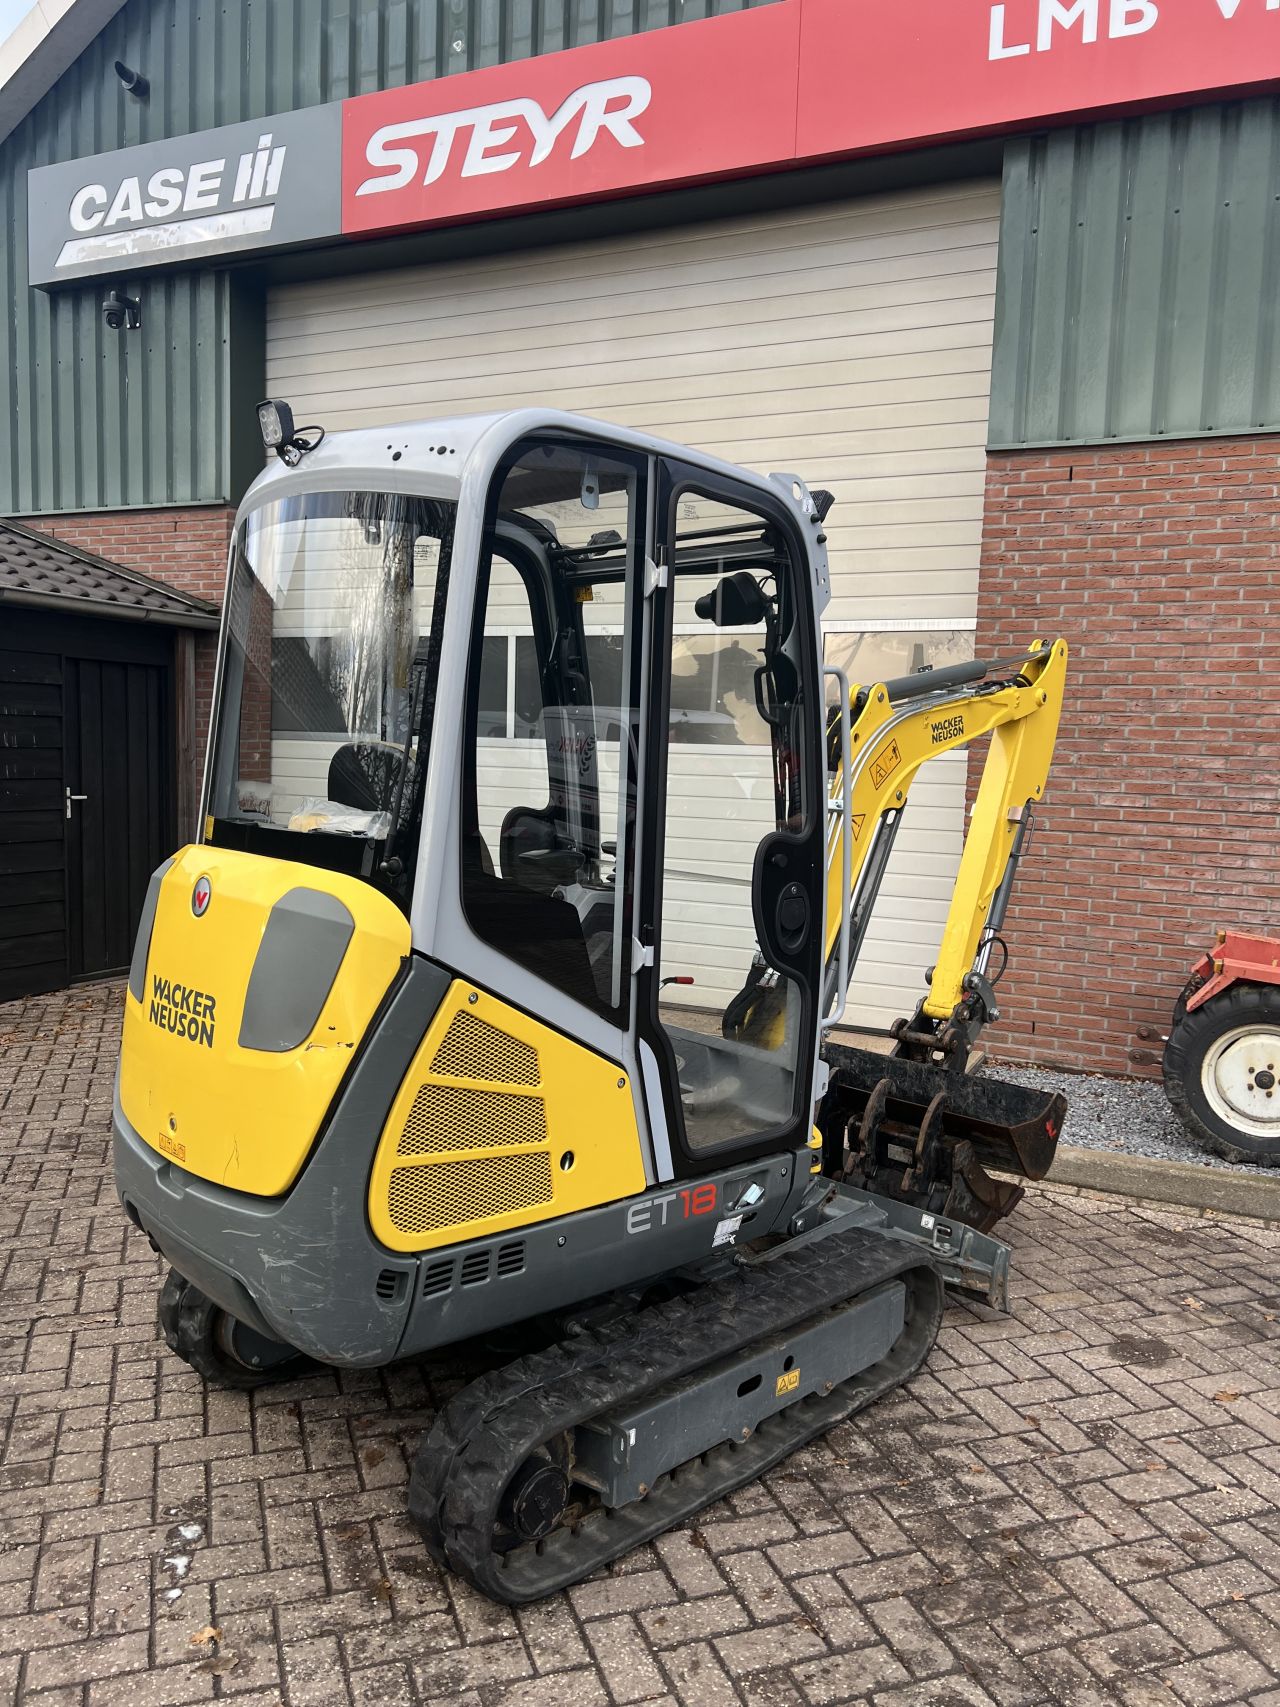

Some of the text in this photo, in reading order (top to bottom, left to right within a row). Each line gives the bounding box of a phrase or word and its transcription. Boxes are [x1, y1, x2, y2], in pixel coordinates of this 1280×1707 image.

[988, 0, 1159, 61] LMB
[355, 75, 652, 197] STEYR
[69, 158, 226, 233] CASE
[931, 715, 964, 733] WACKER
[931, 726, 964, 744] NEUSON
[153, 974, 216, 1022] WACKER
[149, 1000, 215, 1048] NEUSON
